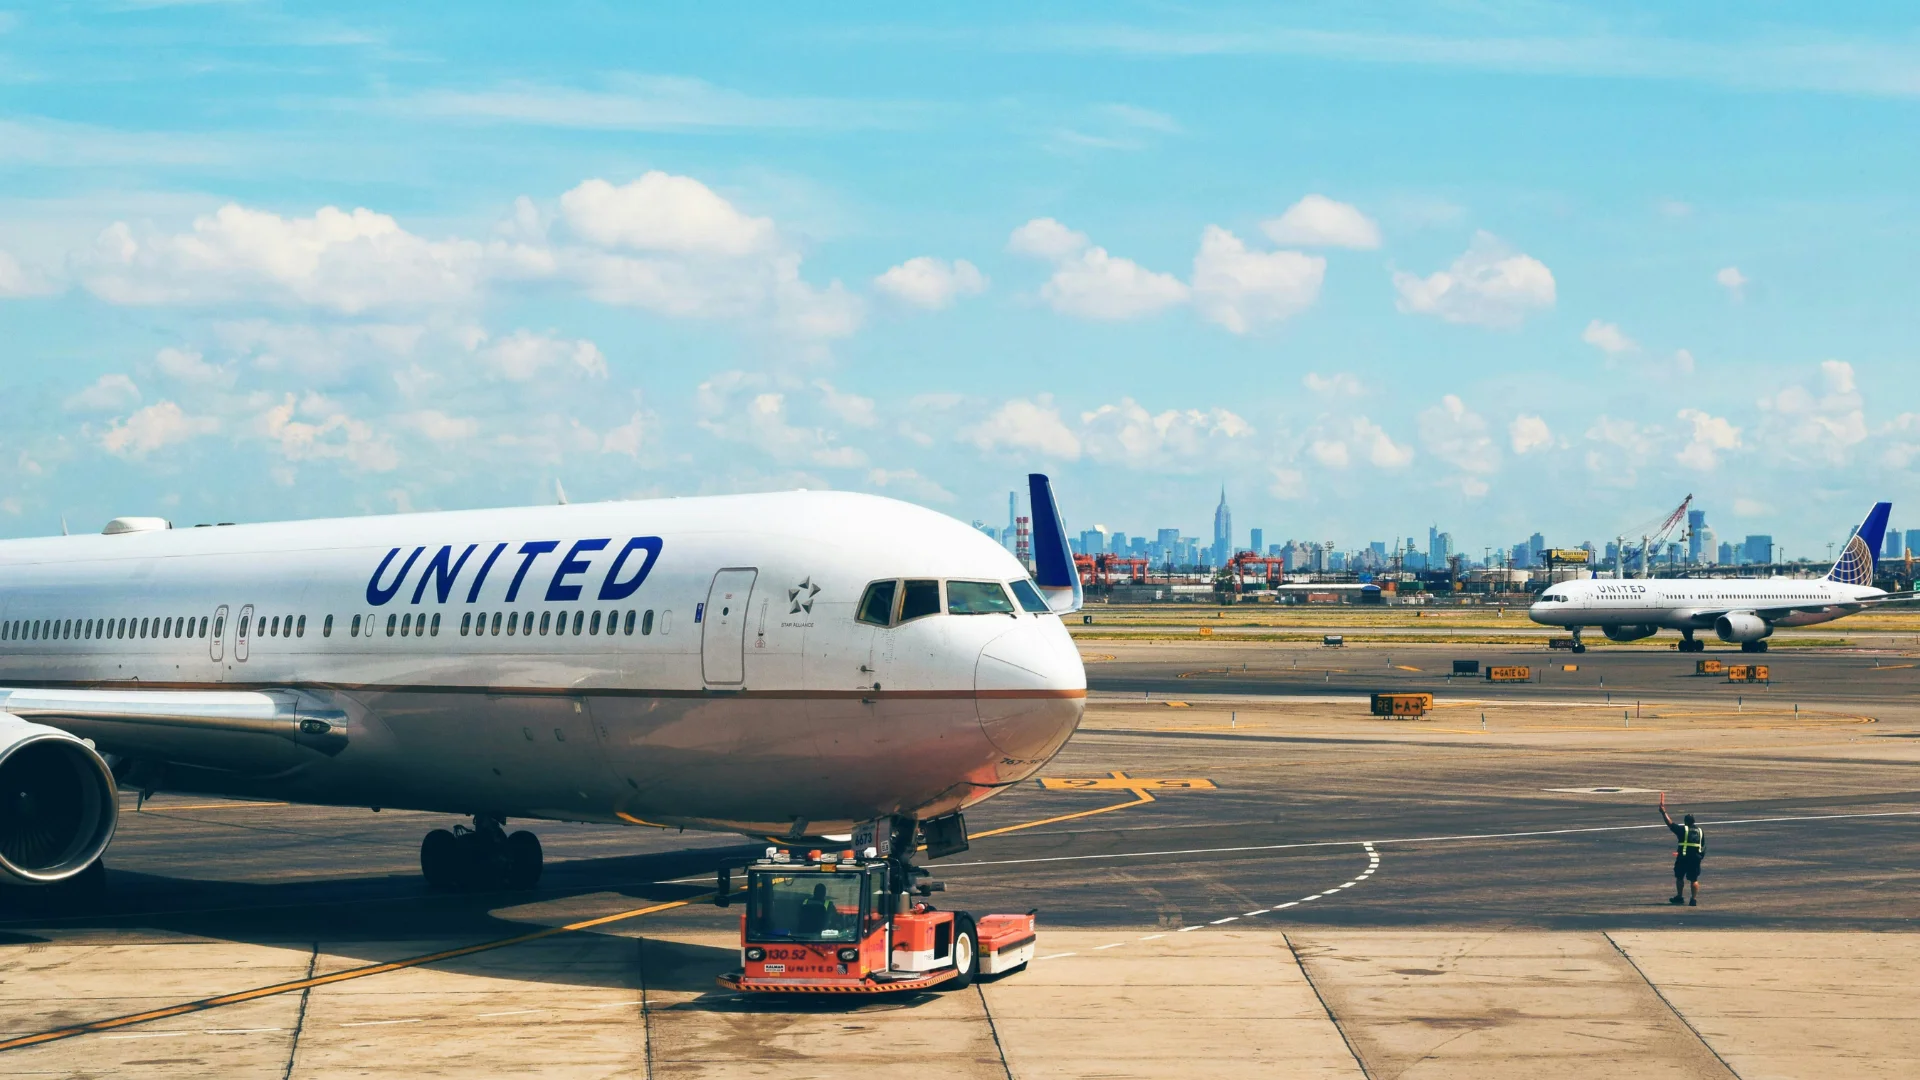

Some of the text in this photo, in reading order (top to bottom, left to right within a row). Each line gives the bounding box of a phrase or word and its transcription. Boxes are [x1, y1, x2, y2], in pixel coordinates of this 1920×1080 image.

[366, 535, 663, 607] UNITED
[1597, 585, 1646, 593] UNITED
[1500, 669, 1516, 677] GATE
[1378, 700, 1411, 712] RE A
[855, 832, 873, 846] 6673
